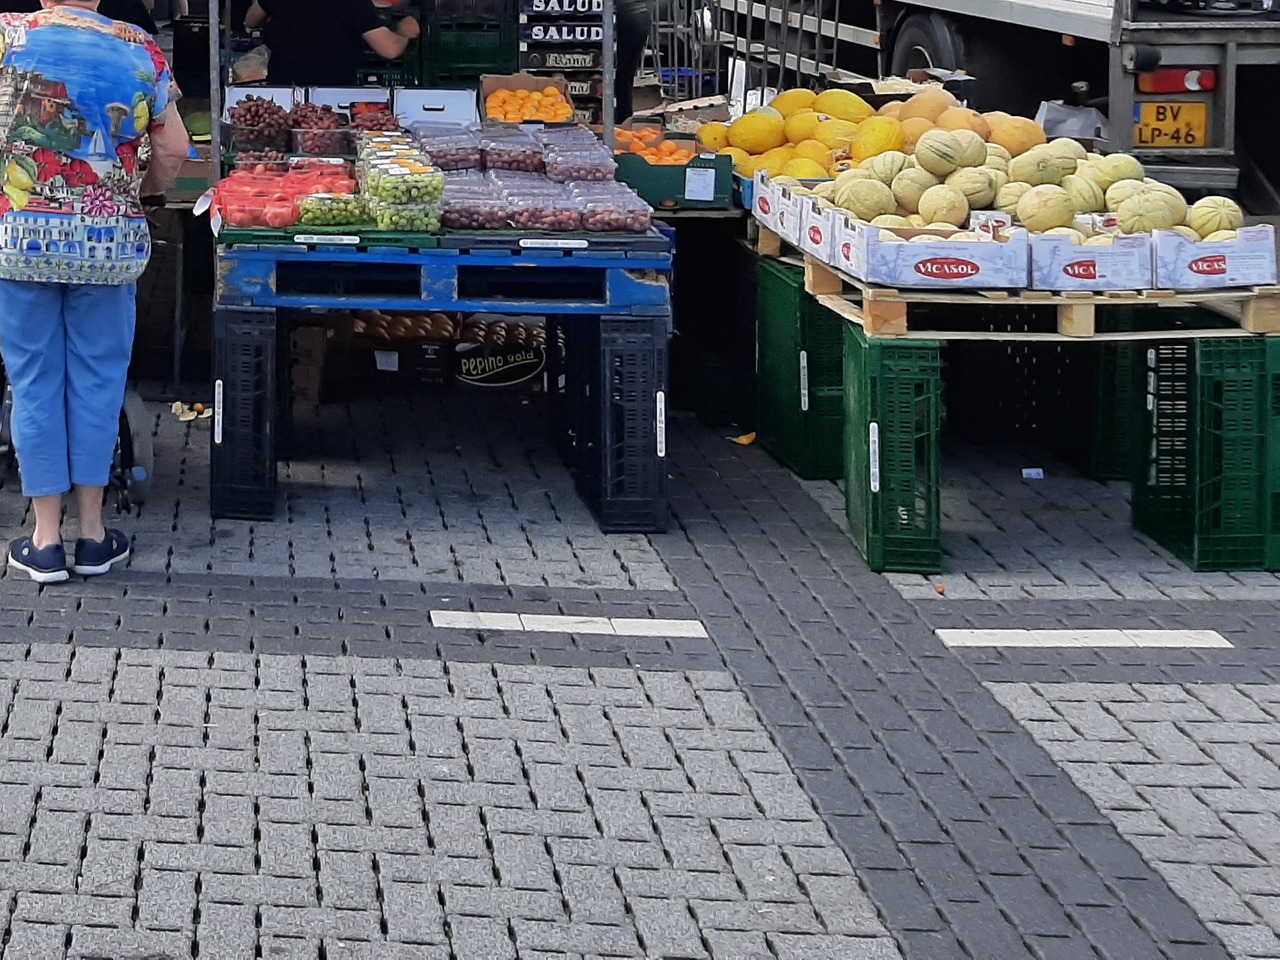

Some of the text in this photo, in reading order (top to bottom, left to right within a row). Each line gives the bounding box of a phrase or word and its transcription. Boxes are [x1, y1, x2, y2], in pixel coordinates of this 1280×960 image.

[531, 26, 603, 40] SALUD
[1155, 105, 1182, 122] BV
[1138, 127, 1197, 144] LP-46
[461, 356, 505, 375] pepino
